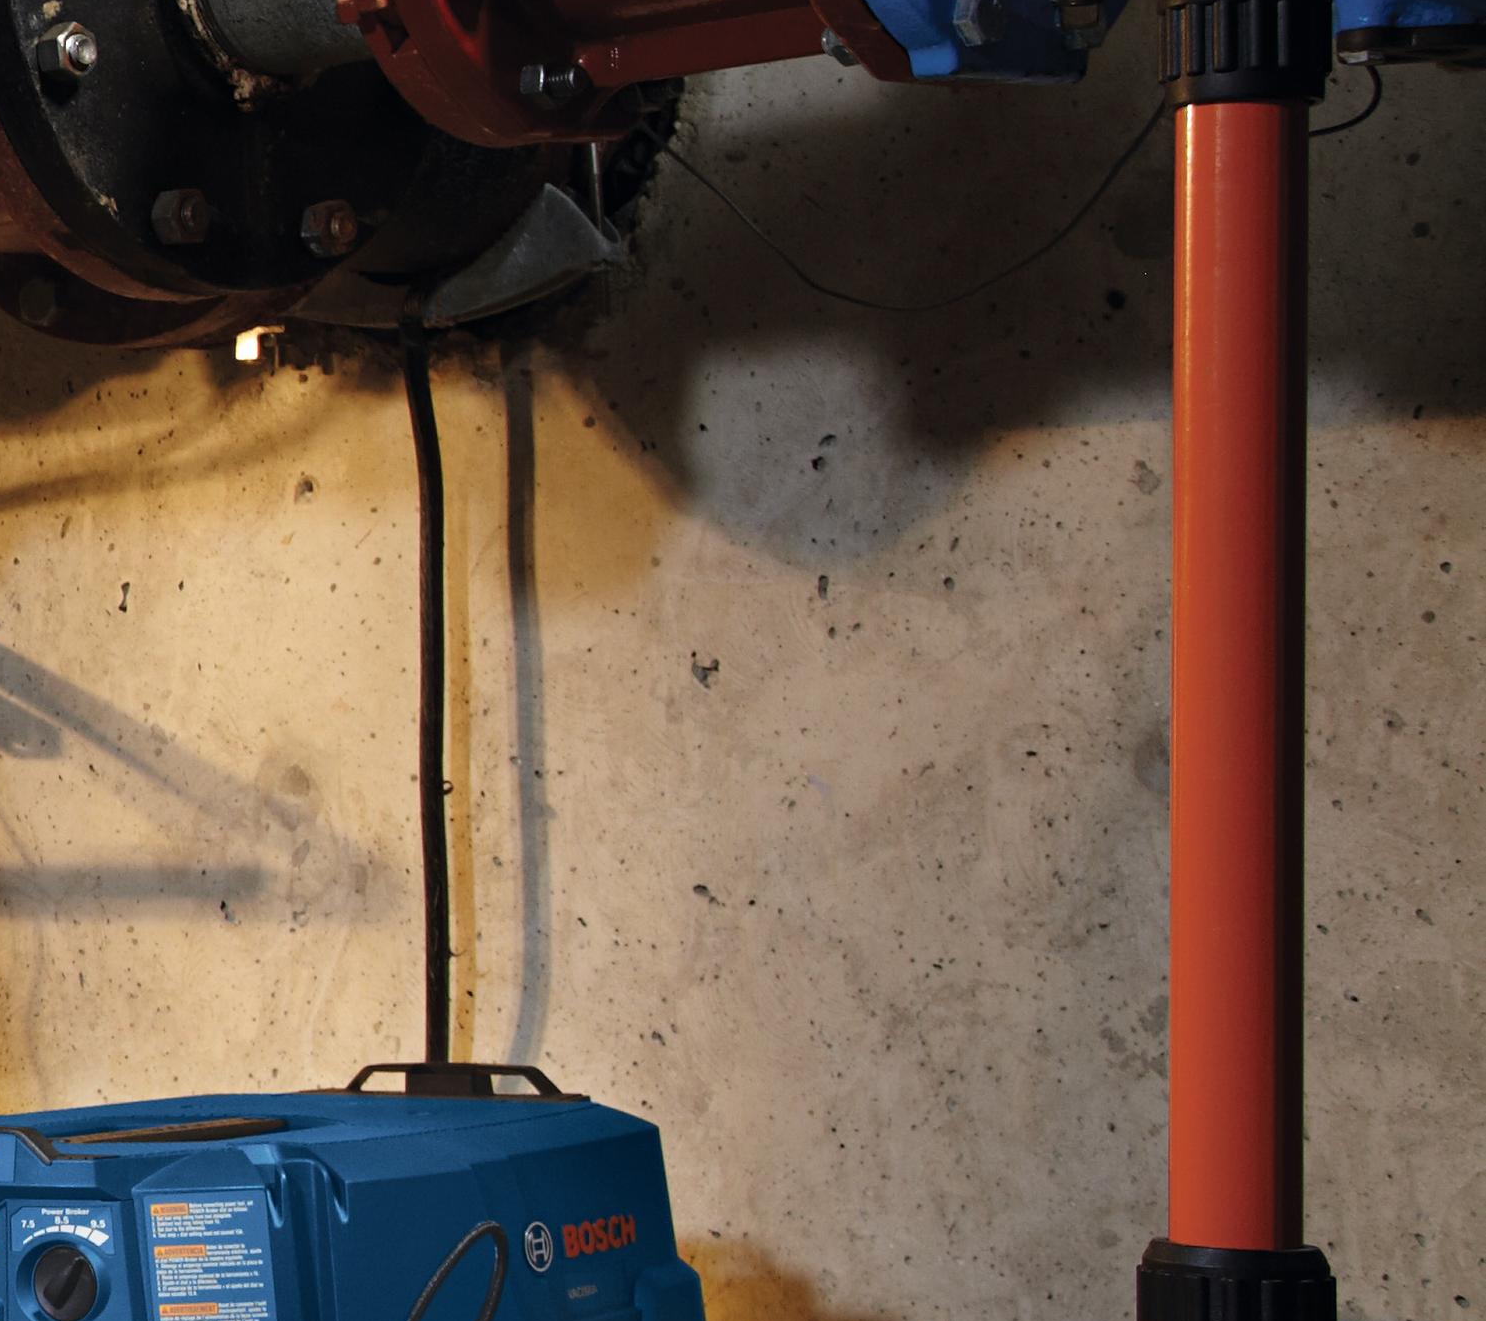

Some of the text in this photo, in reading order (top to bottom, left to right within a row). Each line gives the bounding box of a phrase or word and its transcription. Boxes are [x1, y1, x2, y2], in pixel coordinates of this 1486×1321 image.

[41, 1208, 90, 1216] Power Broker
[21, 1220, 36, 1229] 7.5
[54, 1216, 70, 1225] 8.5
[90, 1220, 107, 1229] 9.5
[562, 1214, 636, 1258] BOSCH
